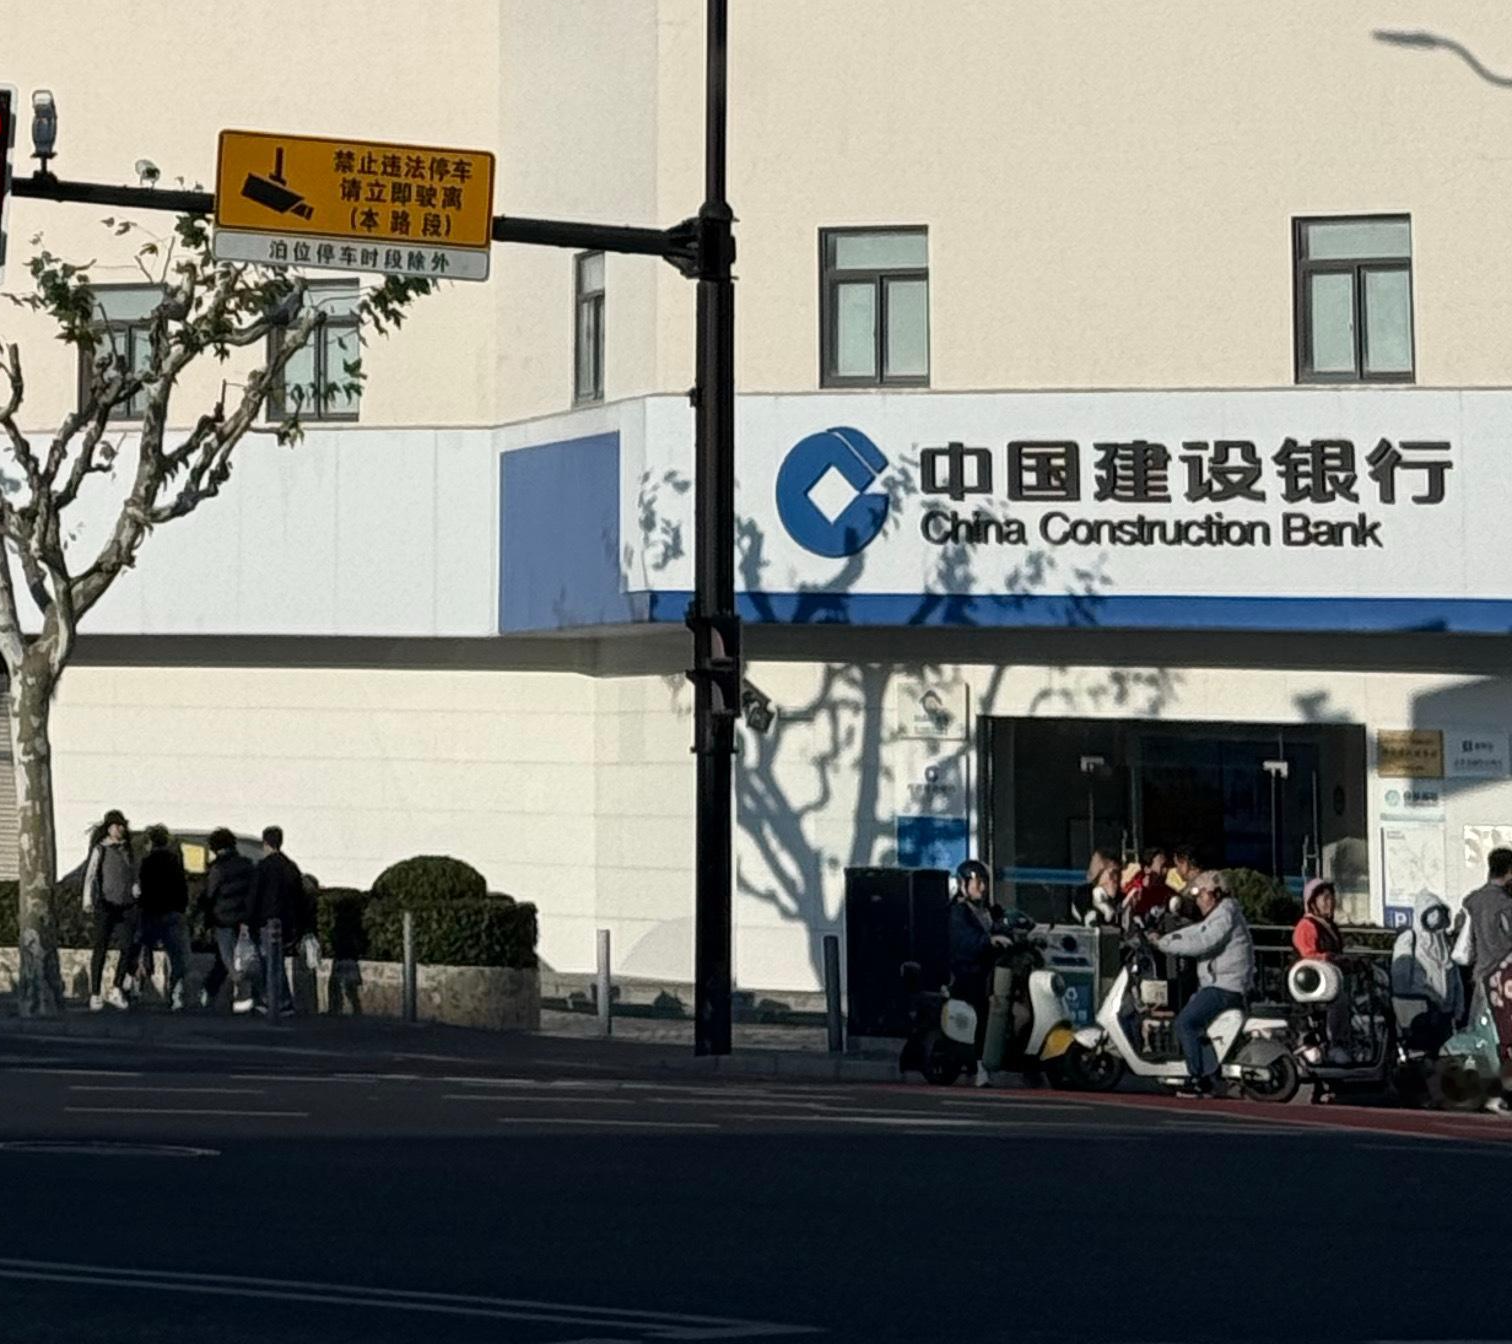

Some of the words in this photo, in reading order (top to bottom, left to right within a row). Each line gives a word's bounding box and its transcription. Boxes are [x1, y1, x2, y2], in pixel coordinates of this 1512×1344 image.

[333, 150, 474, 182] 禁止违法停车
[340, 178, 464, 210] 请立即驶离
[268, 240, 451, 272] 泊位停车时段除外
[921, 438, 1453, 504] 中国建设银行
[921, 511, 1027, 546] China
[1039, 511, 1271, 546] Construction
[1283, 514, 1382, 548] Bank
